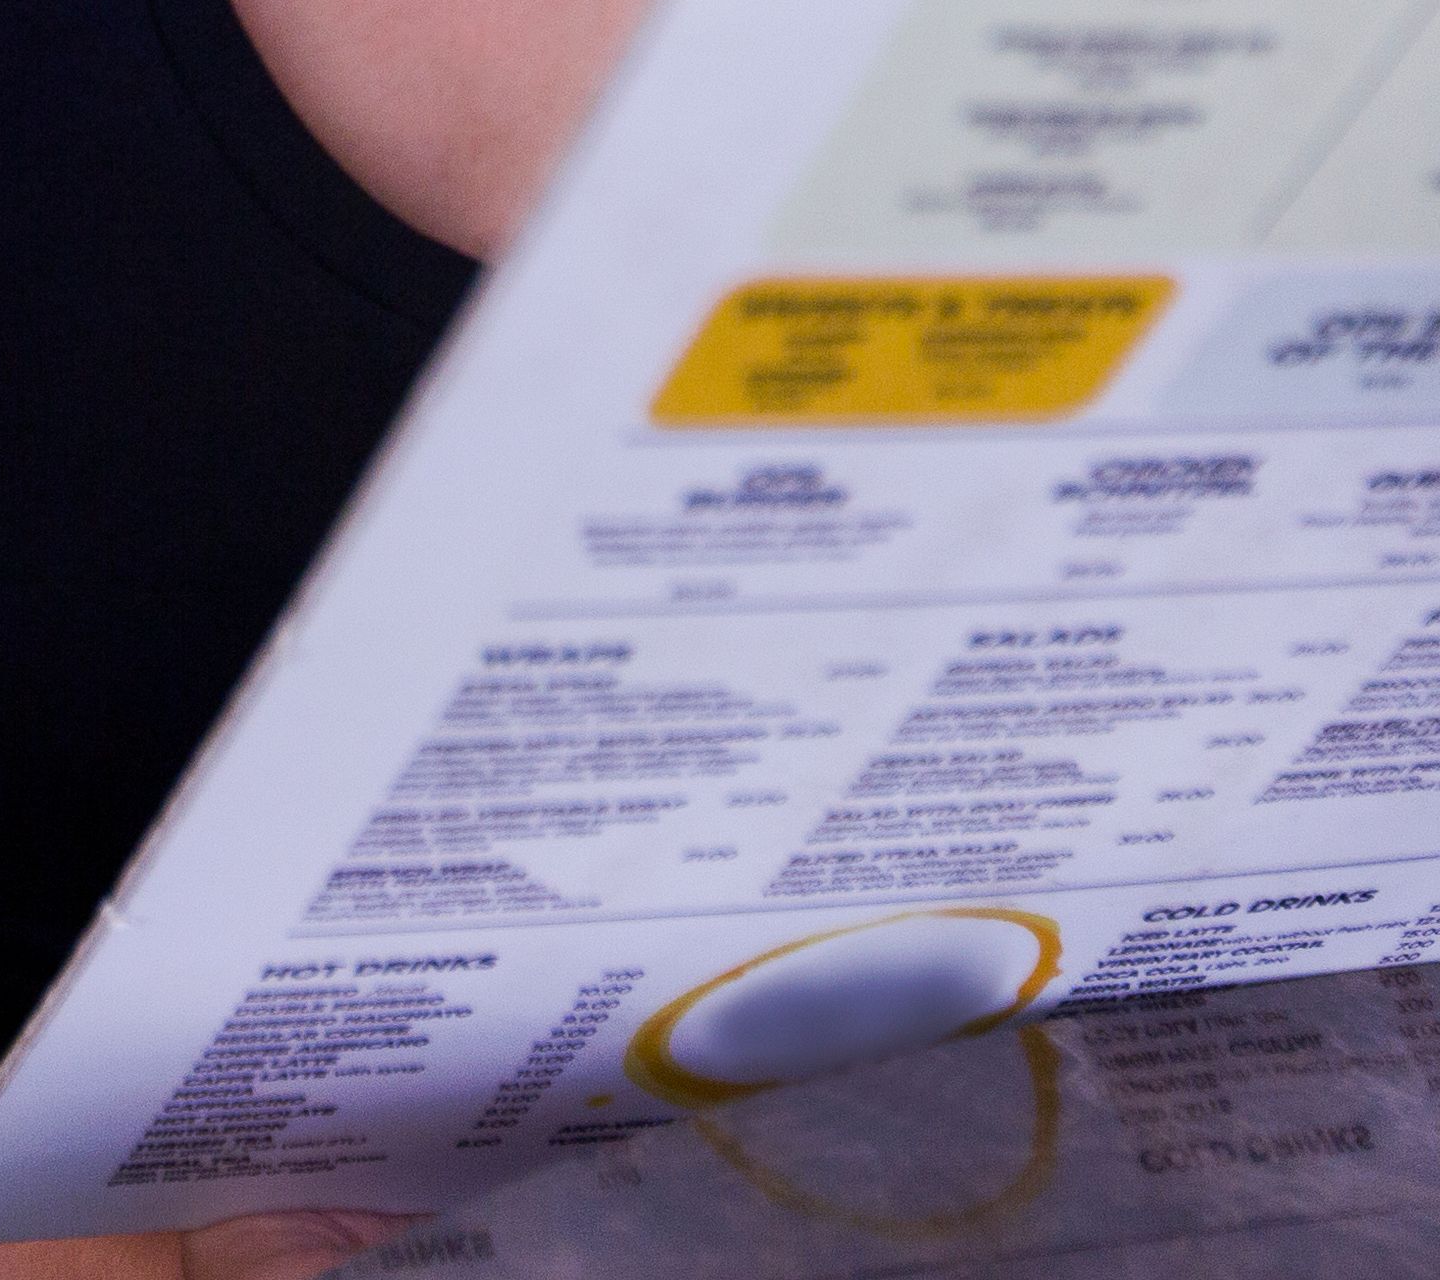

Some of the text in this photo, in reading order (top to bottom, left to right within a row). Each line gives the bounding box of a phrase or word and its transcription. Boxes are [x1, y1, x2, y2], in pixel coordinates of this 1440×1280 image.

[970, 628, 1120, 646] SALADS
[1142, 890, 1376, 922] COLD DRINKS
[1122, 924, 1234, 942] ICED LATTE
[1098, 940, 1324, 968] VIRGIN MARY COCKTAIL
[1108, 938, 1223, 956] LEMONADE
[262, 954, 496, 980] HOT DRINKS
[1082, 970, 1140, 982] COCA
[1144, 964, 1199, 978] COLA
[1138, 976, 1206, 990] WATER
